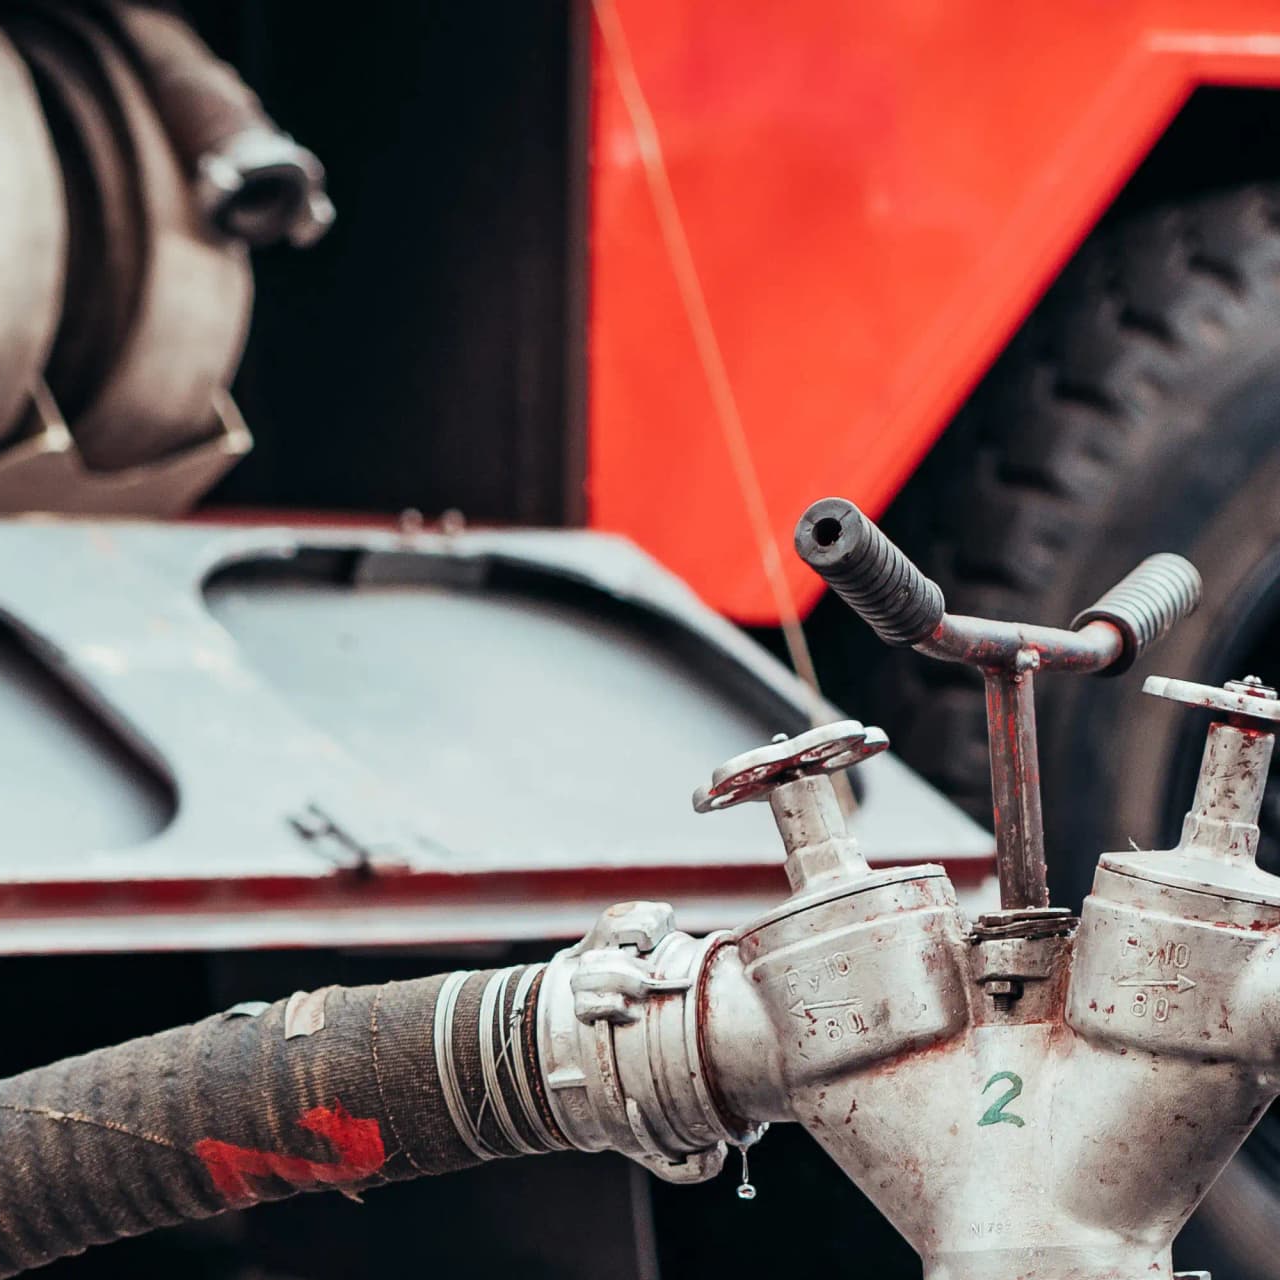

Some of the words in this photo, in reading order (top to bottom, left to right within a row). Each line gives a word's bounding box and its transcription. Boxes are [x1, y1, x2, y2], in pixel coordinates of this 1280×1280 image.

[1131, 992, 1169, 1021] 80
[825, 1009, 862, 1041] 80
[977, 1071, 1025, 1128] 2
